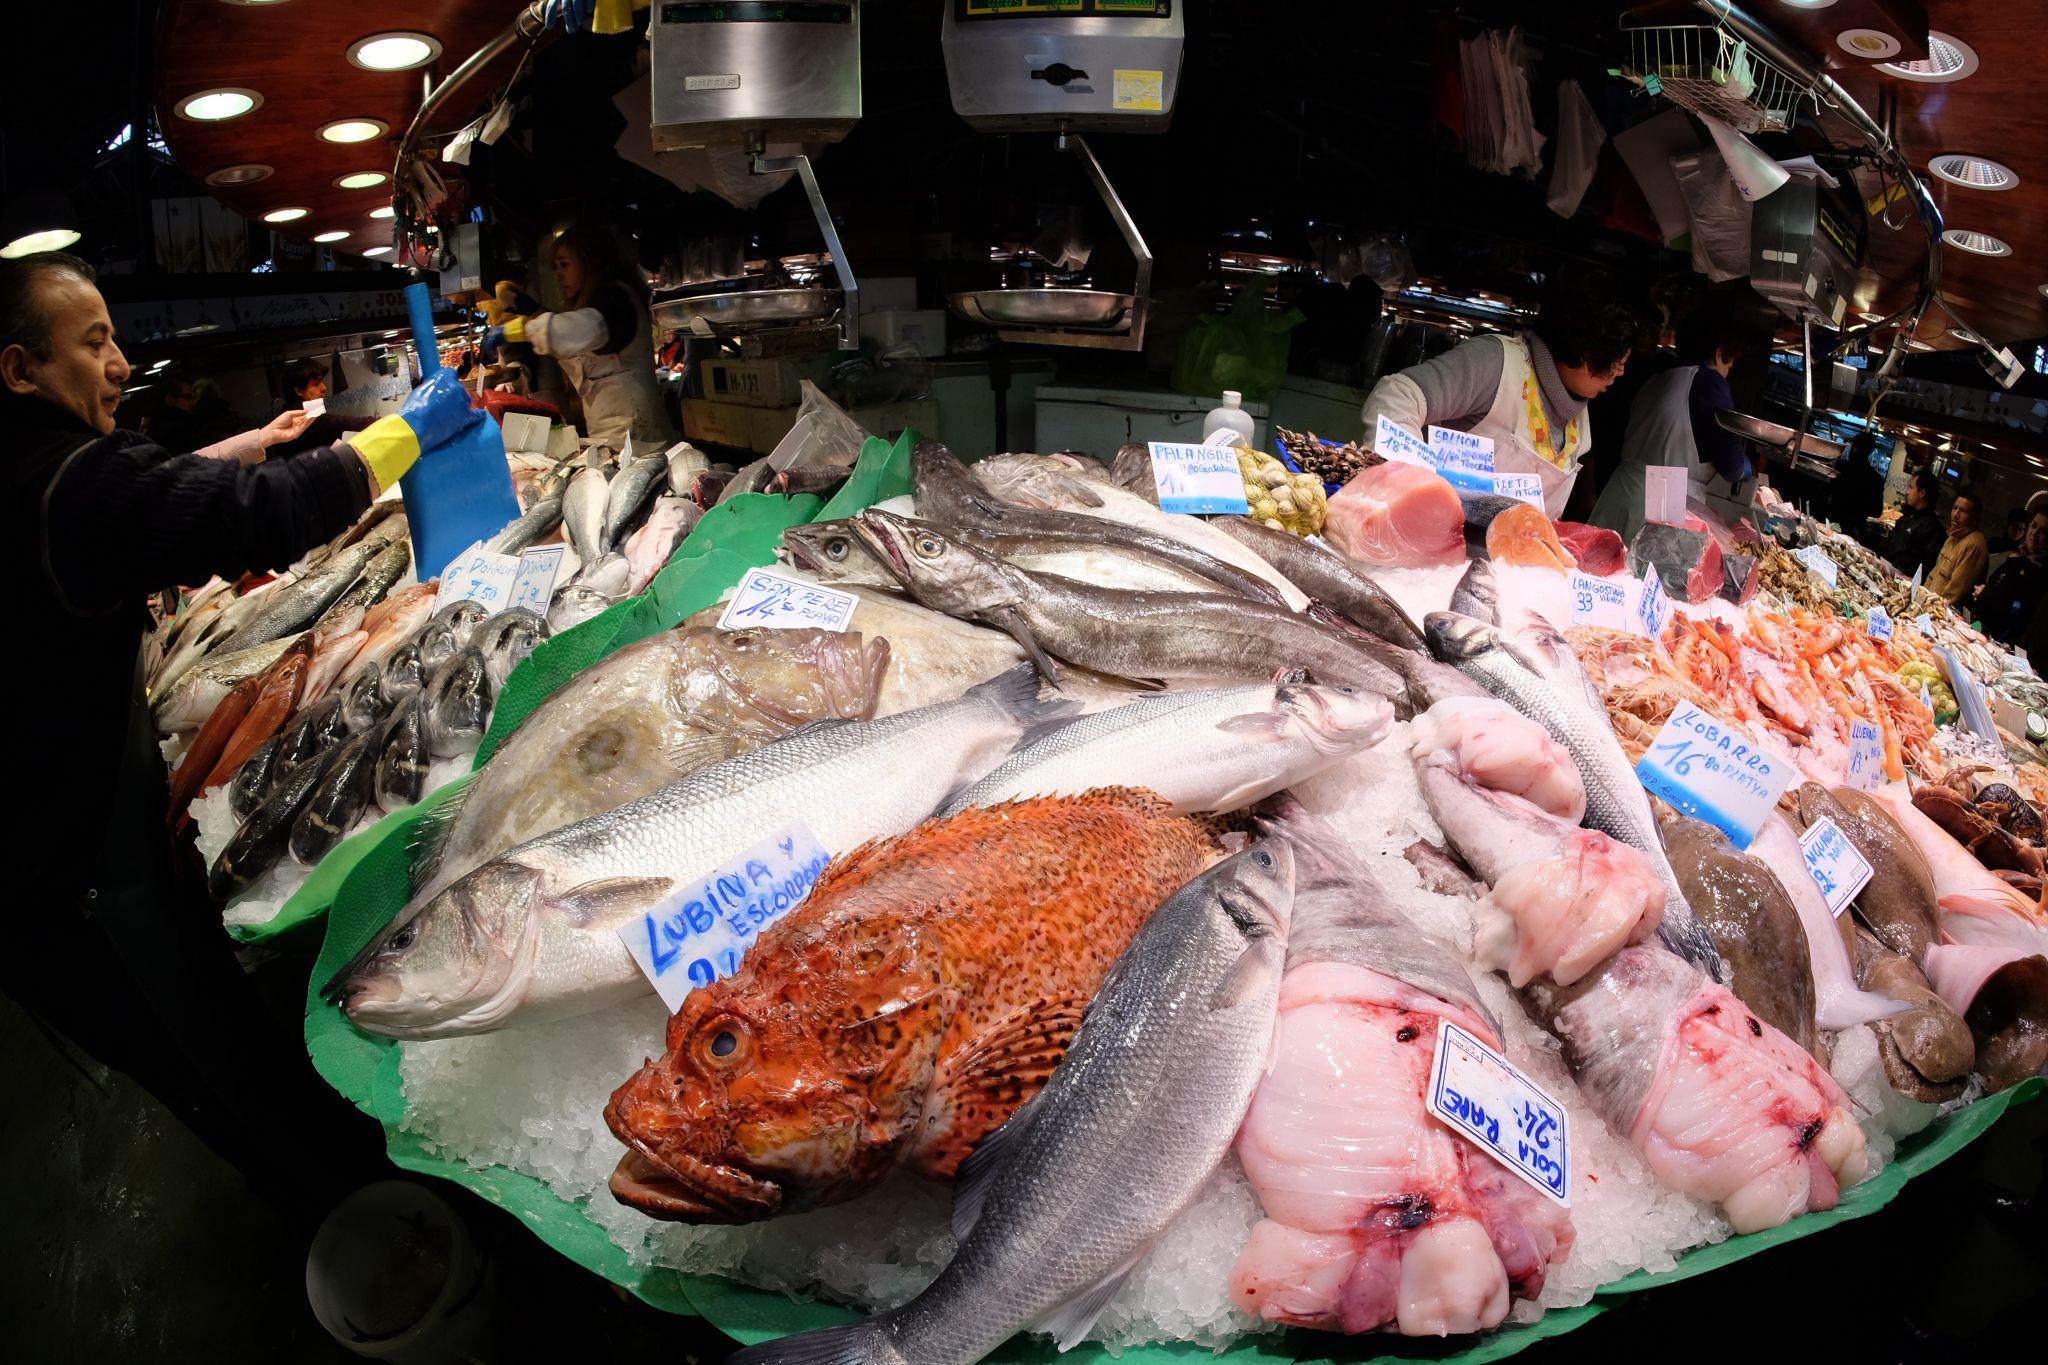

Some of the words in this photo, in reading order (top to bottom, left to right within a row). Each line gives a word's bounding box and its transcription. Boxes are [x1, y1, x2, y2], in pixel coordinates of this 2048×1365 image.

[1671, 710, 1771, 776] LLOBARRO
[645, 858, 774, 970] LUBINA
[1443, 1087, 1501, 1146] RAPE
[1518, 1140, 1563, 1190] COLA
